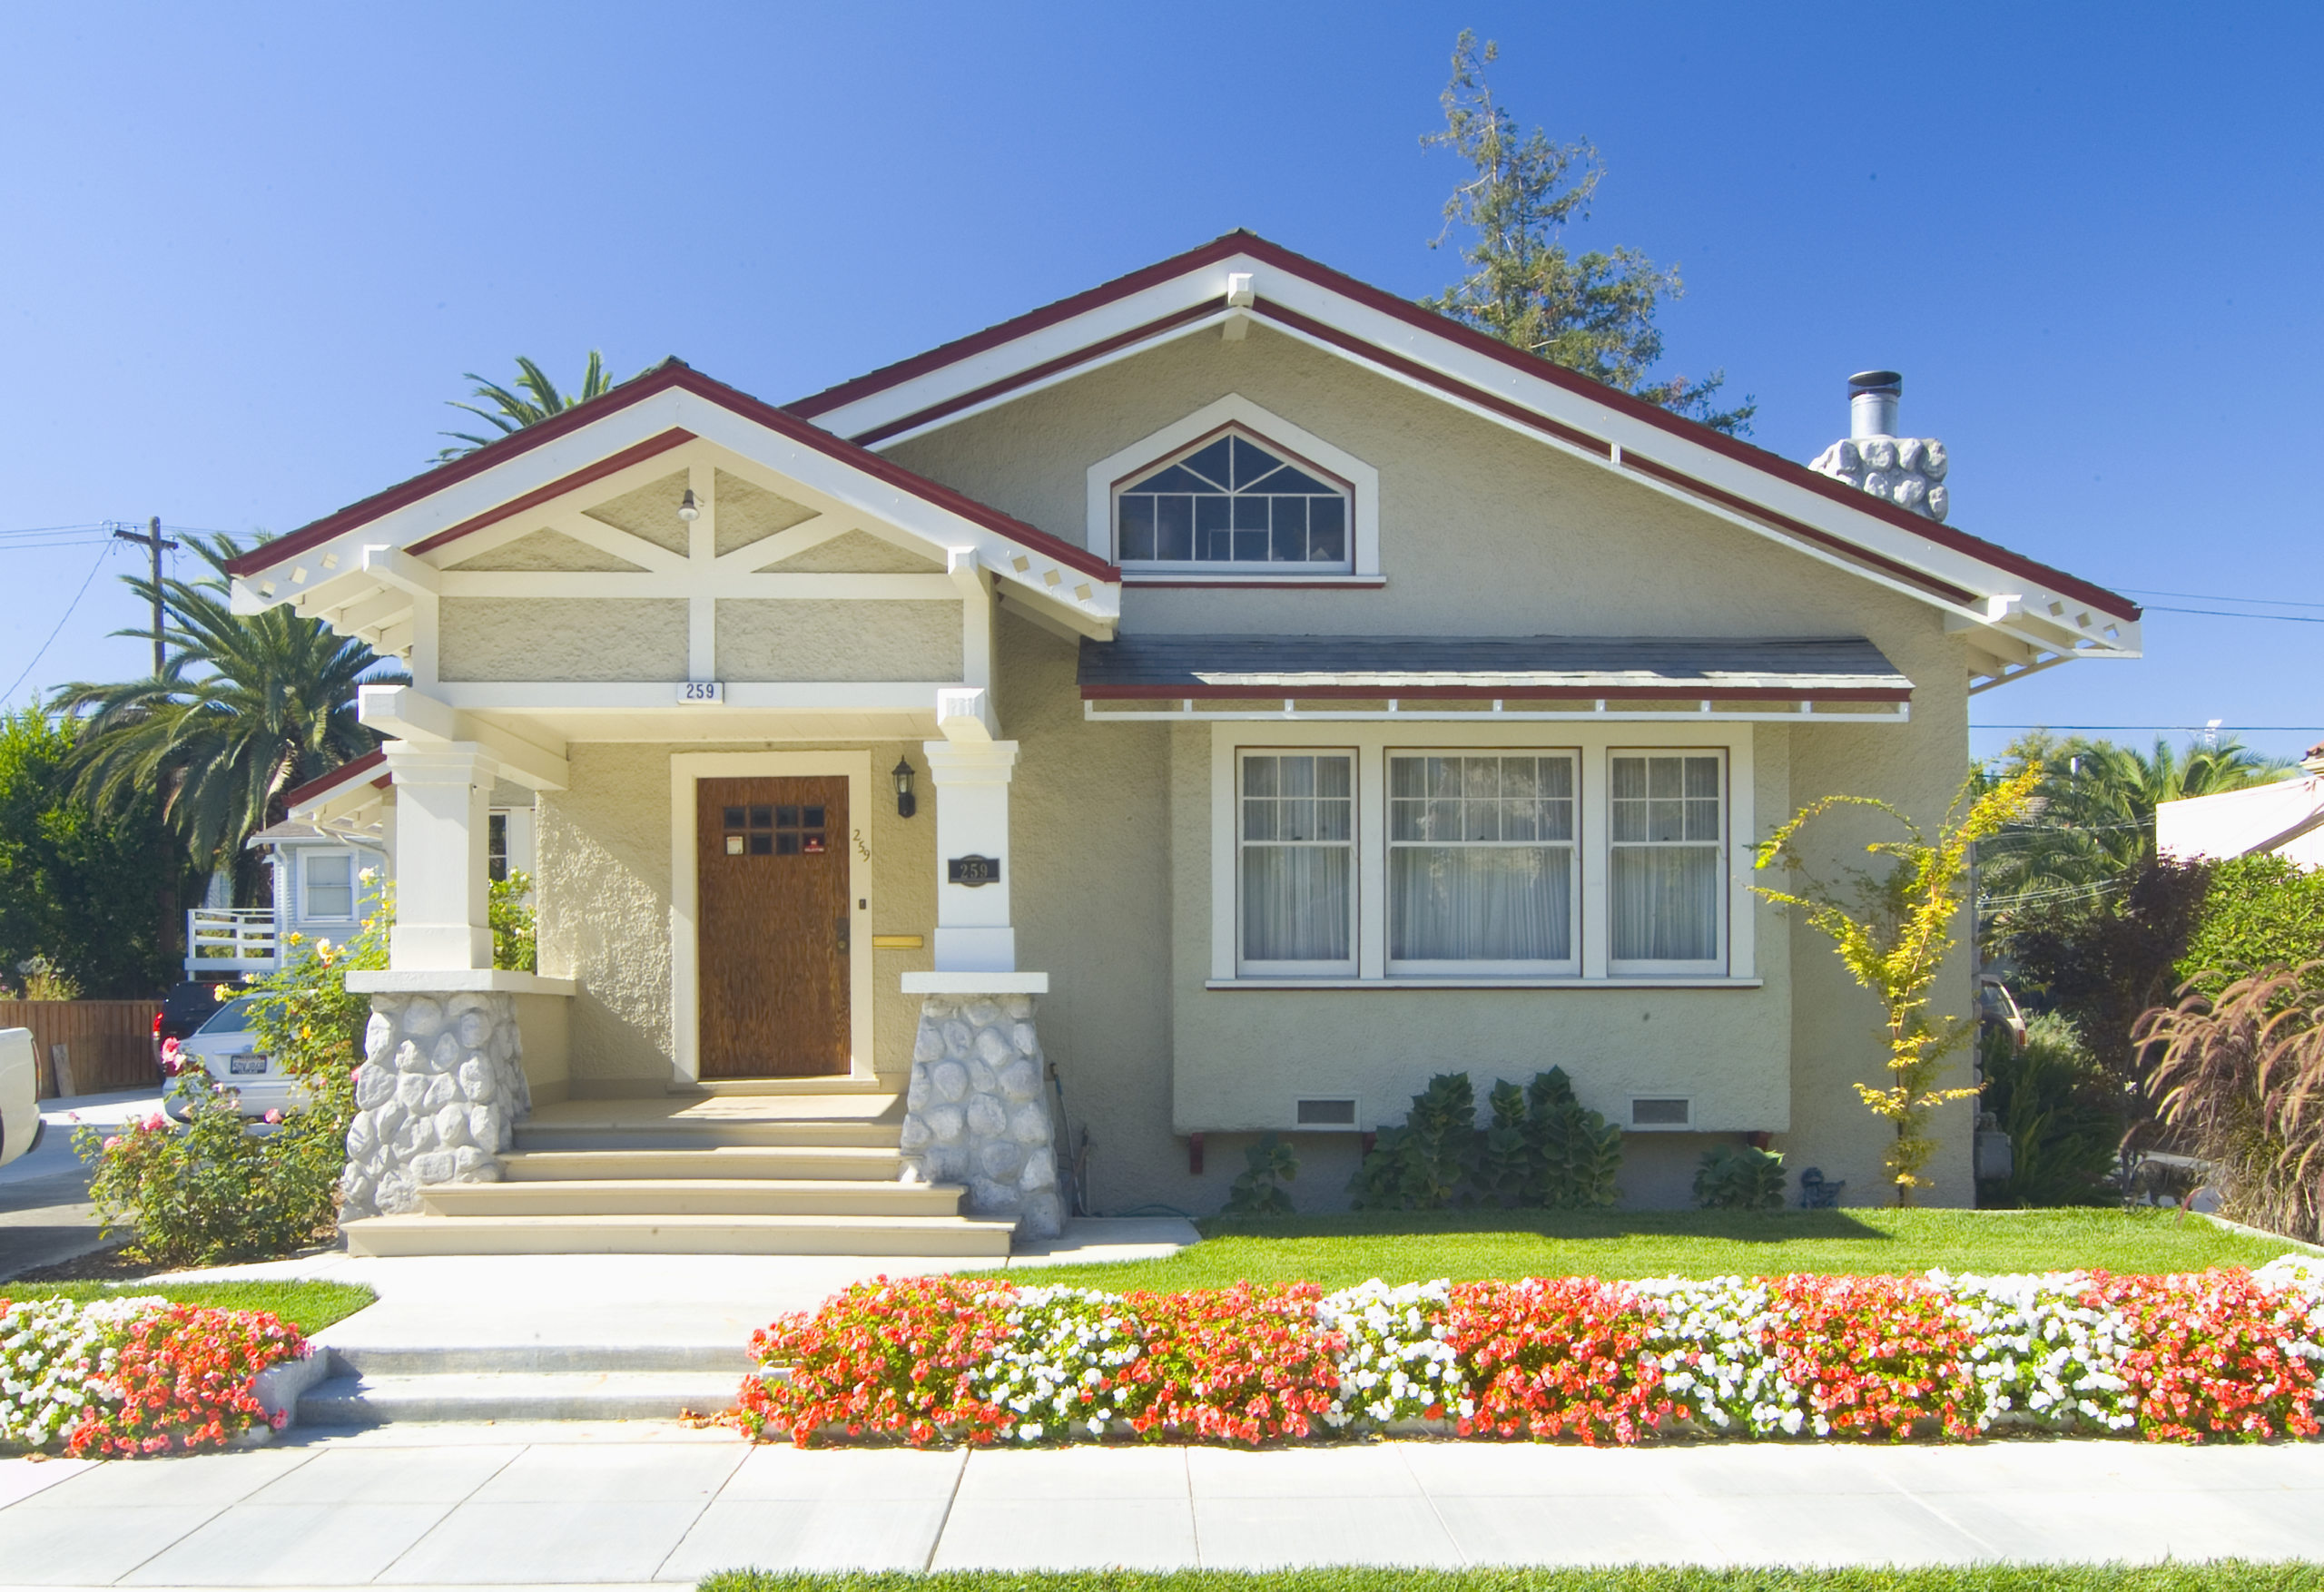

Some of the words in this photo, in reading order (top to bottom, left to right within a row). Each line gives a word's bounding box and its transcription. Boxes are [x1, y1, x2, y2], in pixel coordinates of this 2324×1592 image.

[686, 683, 714, 699] 259
[852, 829, 871, 862] 259
[960, 862, 989, 879] 259
